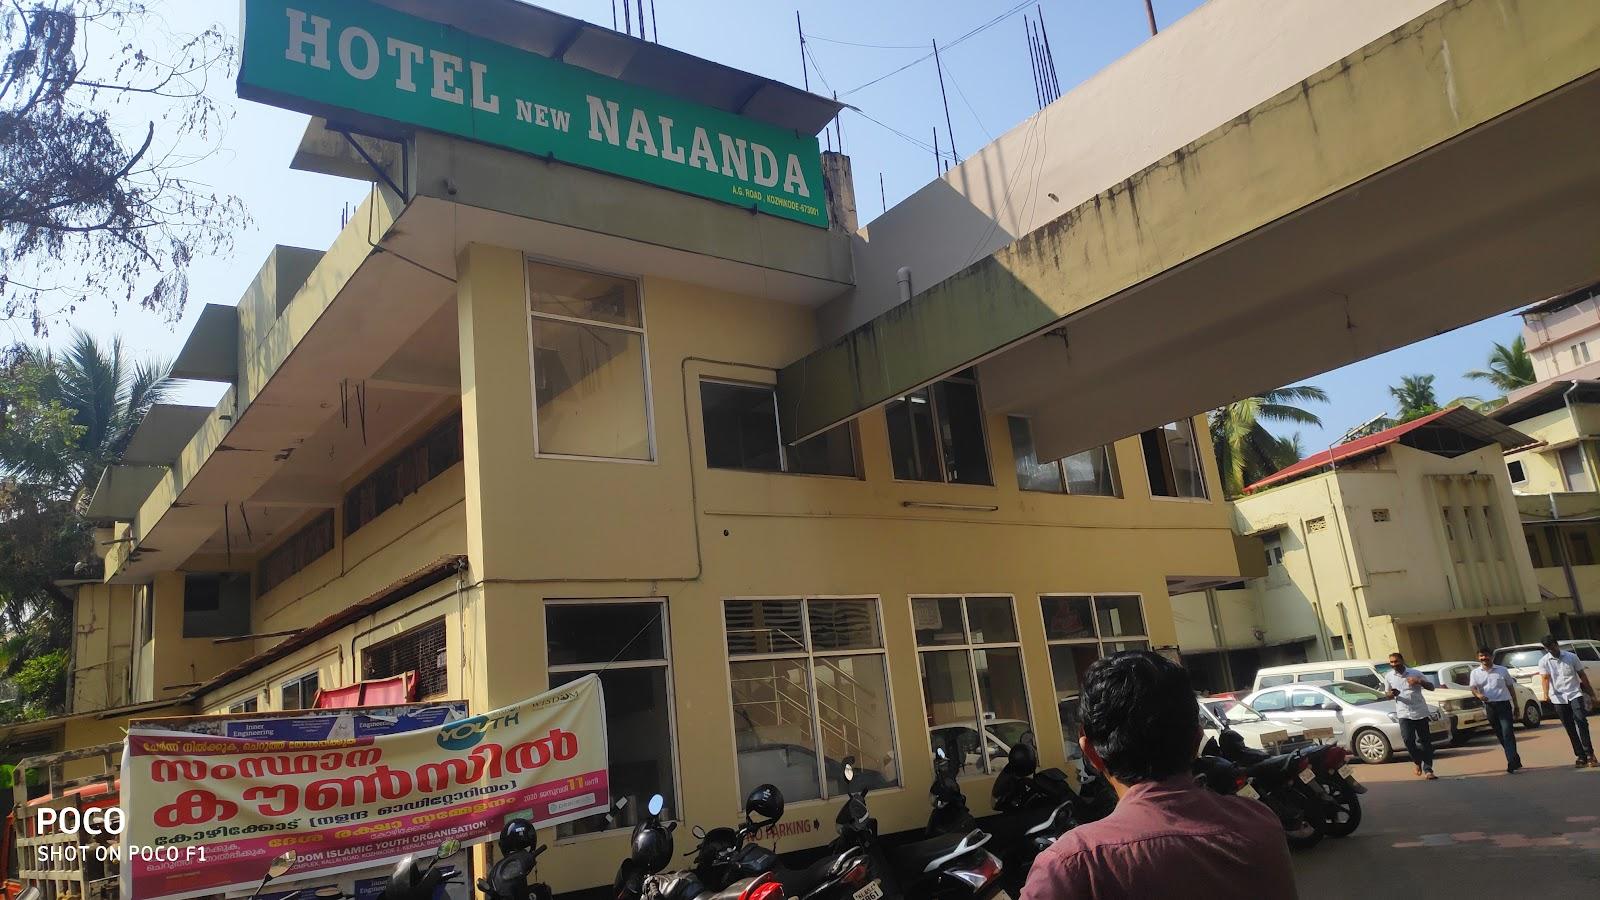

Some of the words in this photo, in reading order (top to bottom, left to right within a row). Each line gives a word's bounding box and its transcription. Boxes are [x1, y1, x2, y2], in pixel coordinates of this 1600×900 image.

[285, 7, 499, 114] HOTEL
[515, 98, 570, 133] NEW
[586, 94, 810, 198] NALANDA
[732, 185, 745, 196] A.G.
[745, 188, 762, 201] ROAD
[766, 194, 819, 216] KOZHIKODE-673001
[233, 729, 275, 739] Engineering
[246, 723, 265, 731] Inner
[438, 711, 520, 742] YOUTH
[151, 747, 383, 783] സംസ്ഥാന
[153, 728, 579, 828] കൗൺസിൽ
[567, 776, 585, 791] 11
[154, 818, 302, 846] കോഴിക്കോട്
[309, 809, 369, 829] (നളന്ദ
[268, 833, 324, 849] ദേശ
[334, 818, 404, 840] രക്ഷാ
[411, 796, 516, 826] സമ്മേളനം
[765, 819, 811, 840] PARKING
[296, 851, 325, 865] DOM
[326, 843, 374, 859] ISLAMIC
[375, 837, 410, 851] YOUTH
[412, 820, 487, 844] ORGANISATION
